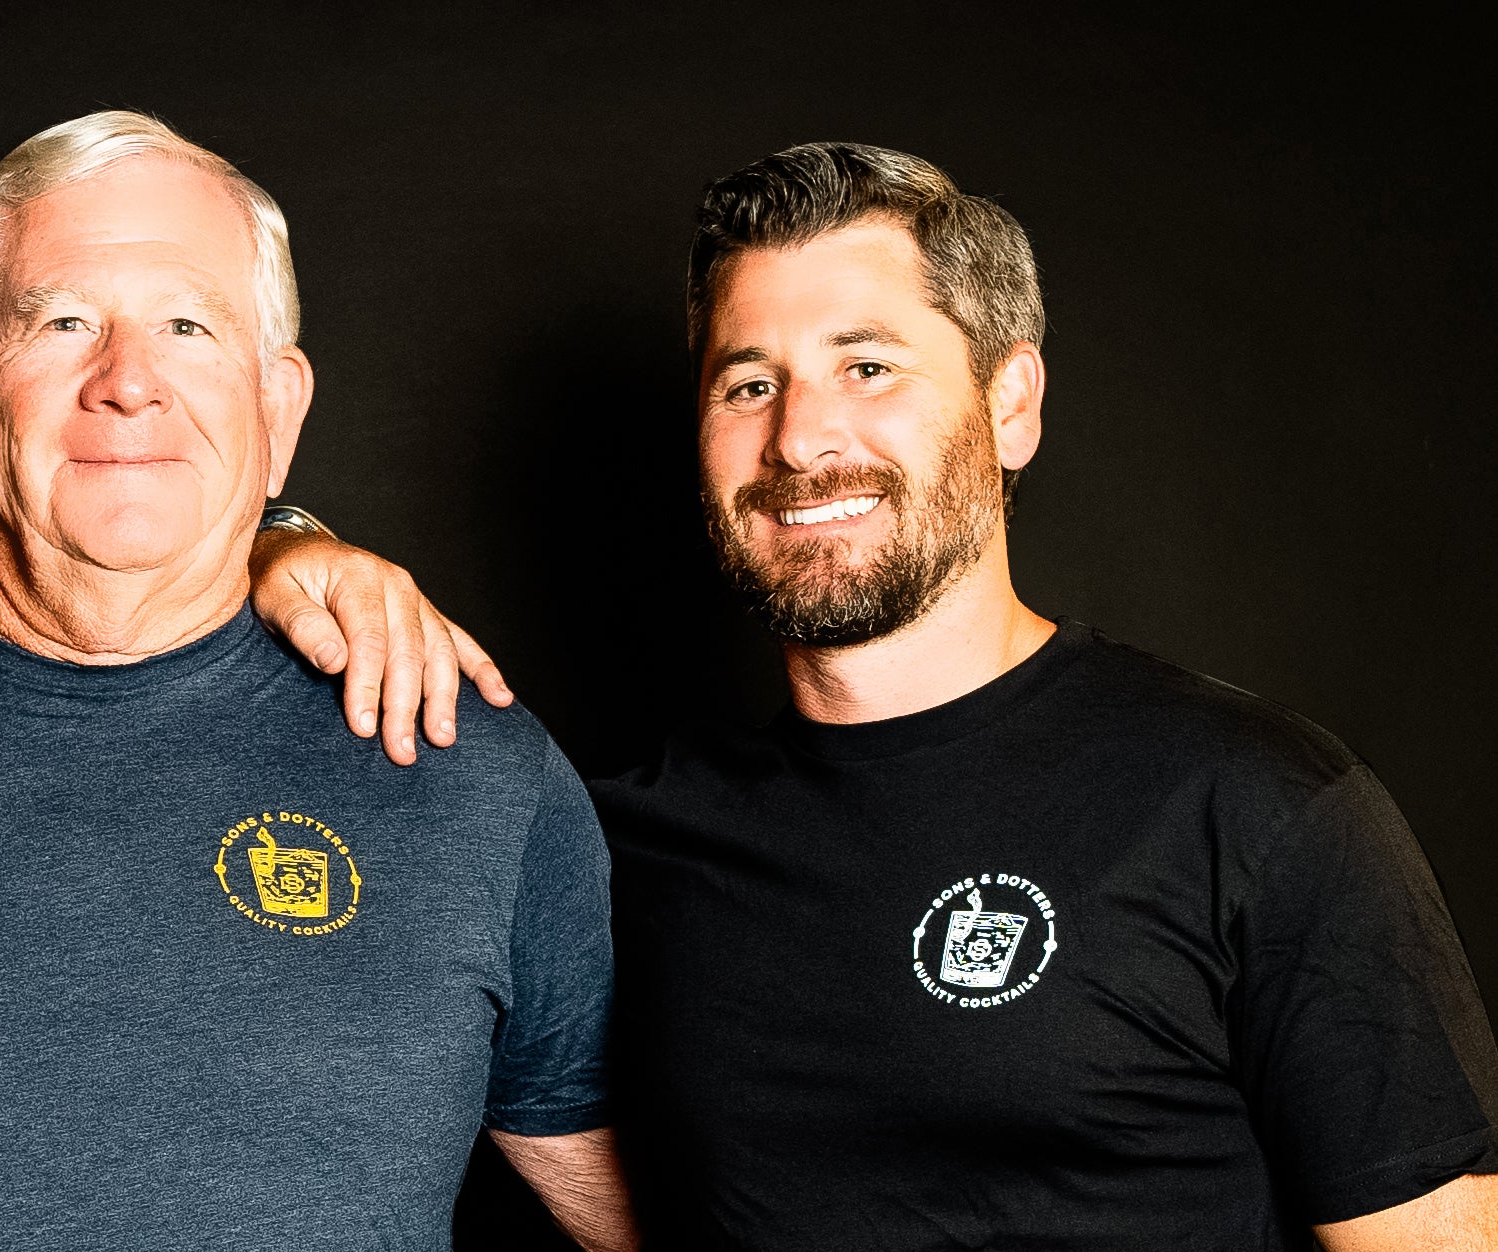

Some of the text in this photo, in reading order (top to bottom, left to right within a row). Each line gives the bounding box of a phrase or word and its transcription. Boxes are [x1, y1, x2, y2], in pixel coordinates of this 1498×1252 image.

[221, 812, 350, 854] SONS & DOTTERS
[229, 895, 357, 936] QUALITY COCKTAILS
[932, 873, 1055, 920] SONS & DOTTERS
[913, 962, 1040, 1008] QUALITY COCKTAILS
